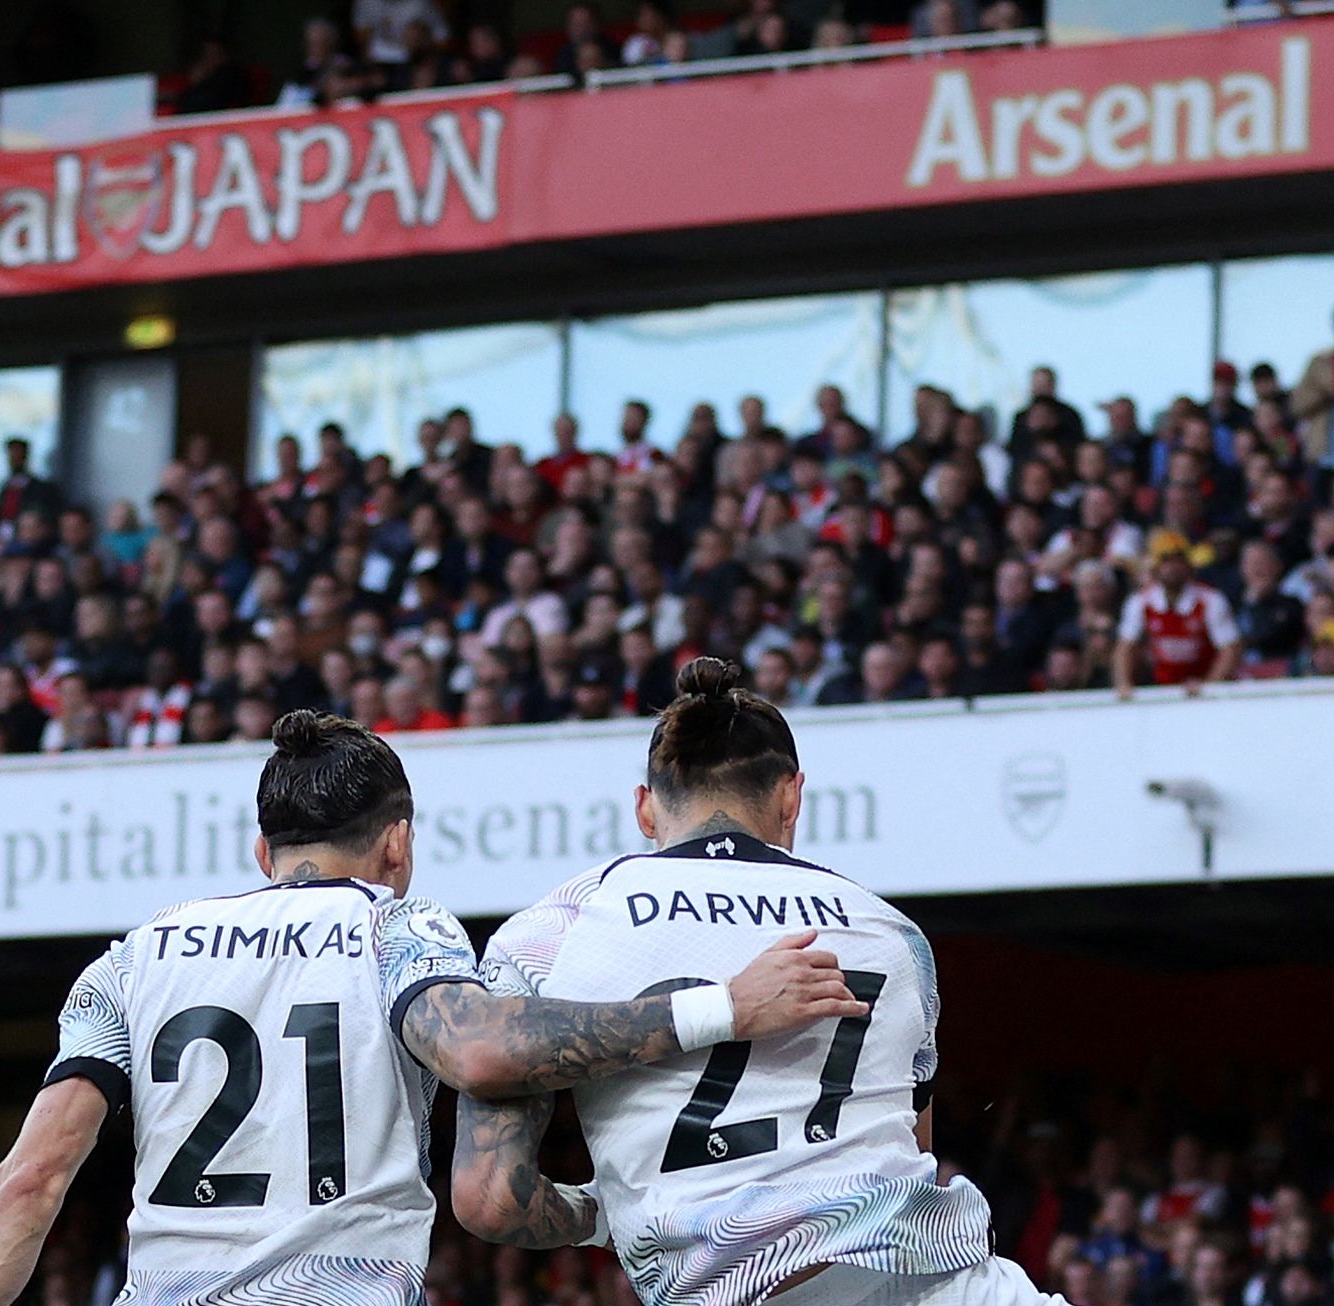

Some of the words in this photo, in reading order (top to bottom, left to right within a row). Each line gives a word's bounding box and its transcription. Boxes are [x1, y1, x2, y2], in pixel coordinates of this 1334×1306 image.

[137, 106, 505, 256] JAPAN
[905, 35, 1311, 187] Arsenal
[153, 921, 363, 960] TSIMIKAS
[626, 890, 851, 927] DARWIN
[148, 1001, 347, 1208] 21
